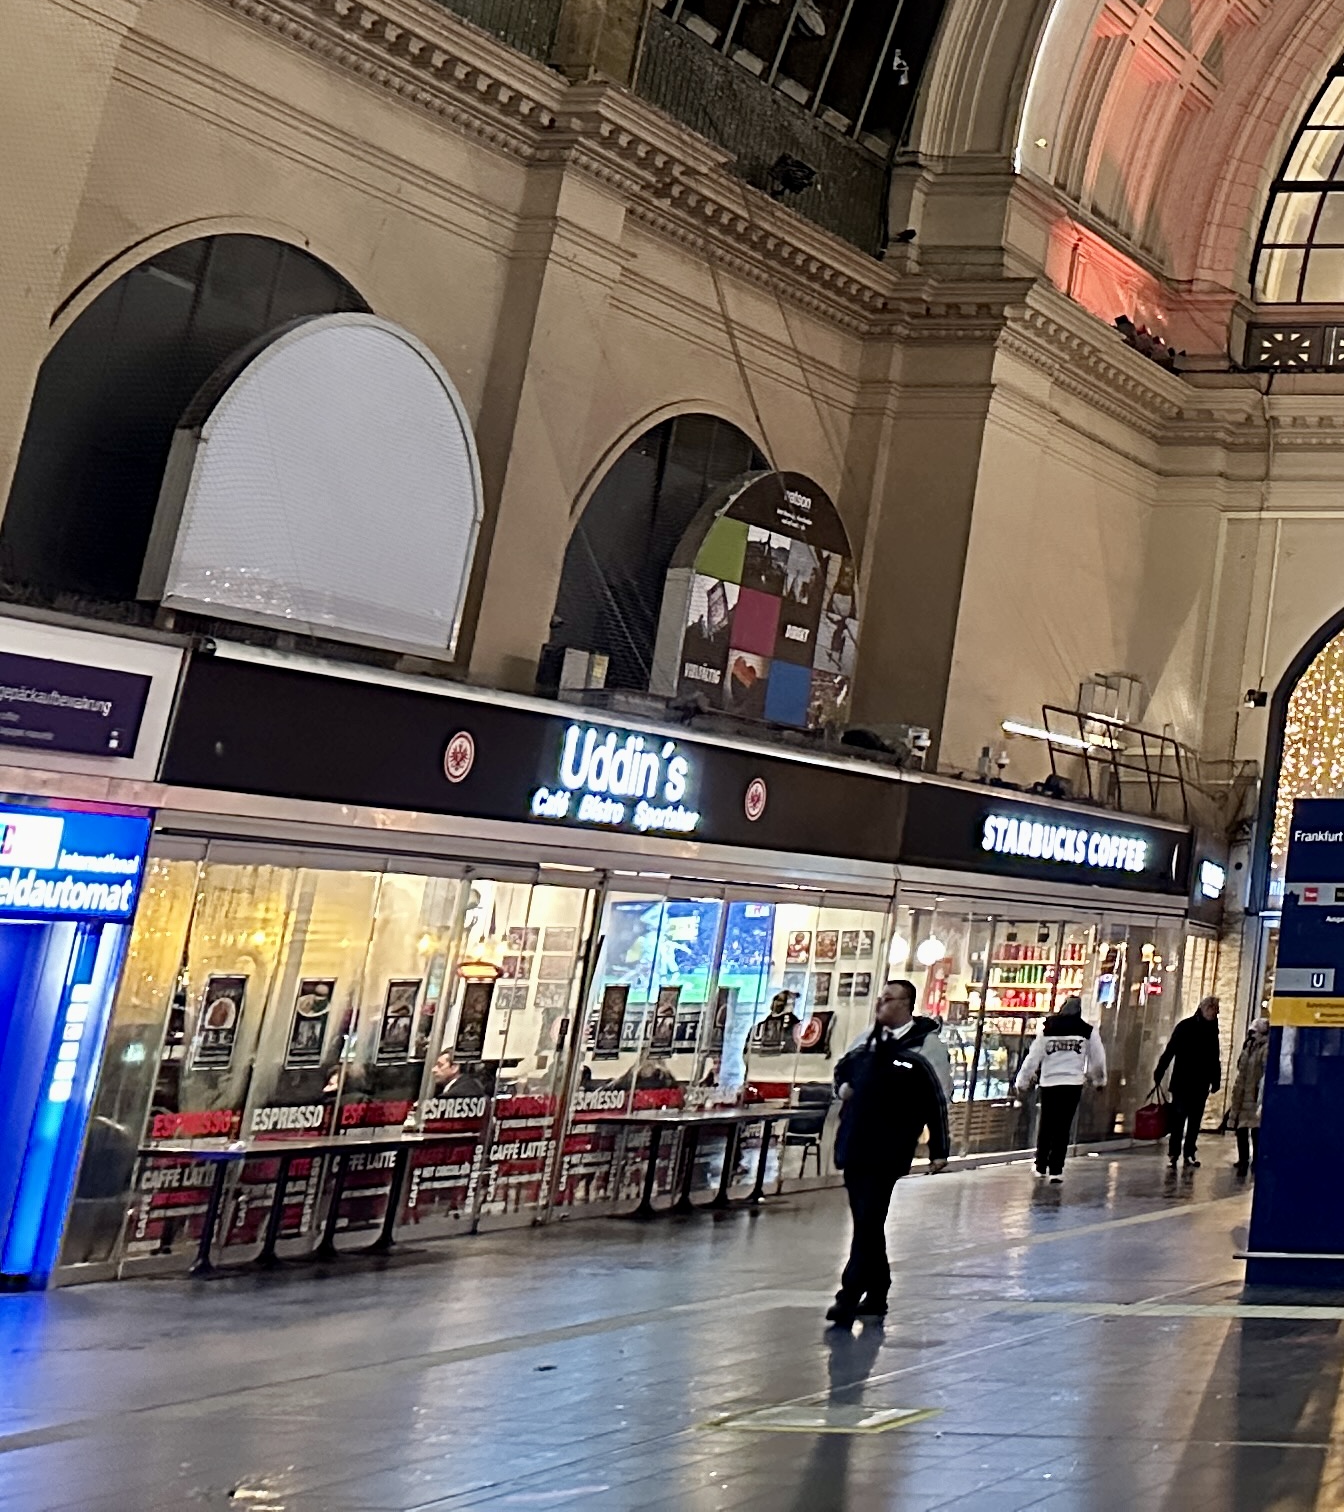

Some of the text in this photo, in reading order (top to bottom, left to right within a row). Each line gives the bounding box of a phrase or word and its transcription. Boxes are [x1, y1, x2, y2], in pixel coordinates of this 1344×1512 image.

[560, 724, 689, 803] Uddin's
[531, 786, 572, 818] Café
[577, 793, 625, 825] Bistro
[982, 814, 1148, 872] STARBUCKS COFFEE
[1294, 830, 1344, 842] Frankfurt
[1313, 973, 1324, 987] U
[420, 1097, 486, 1121] ESPRESSO
[571, 1089, 626, 1112] ESPRESSO
[251, 1104, 324, 1132] ESPRESSO
[520, 1141, 548, 1159] LATTE
